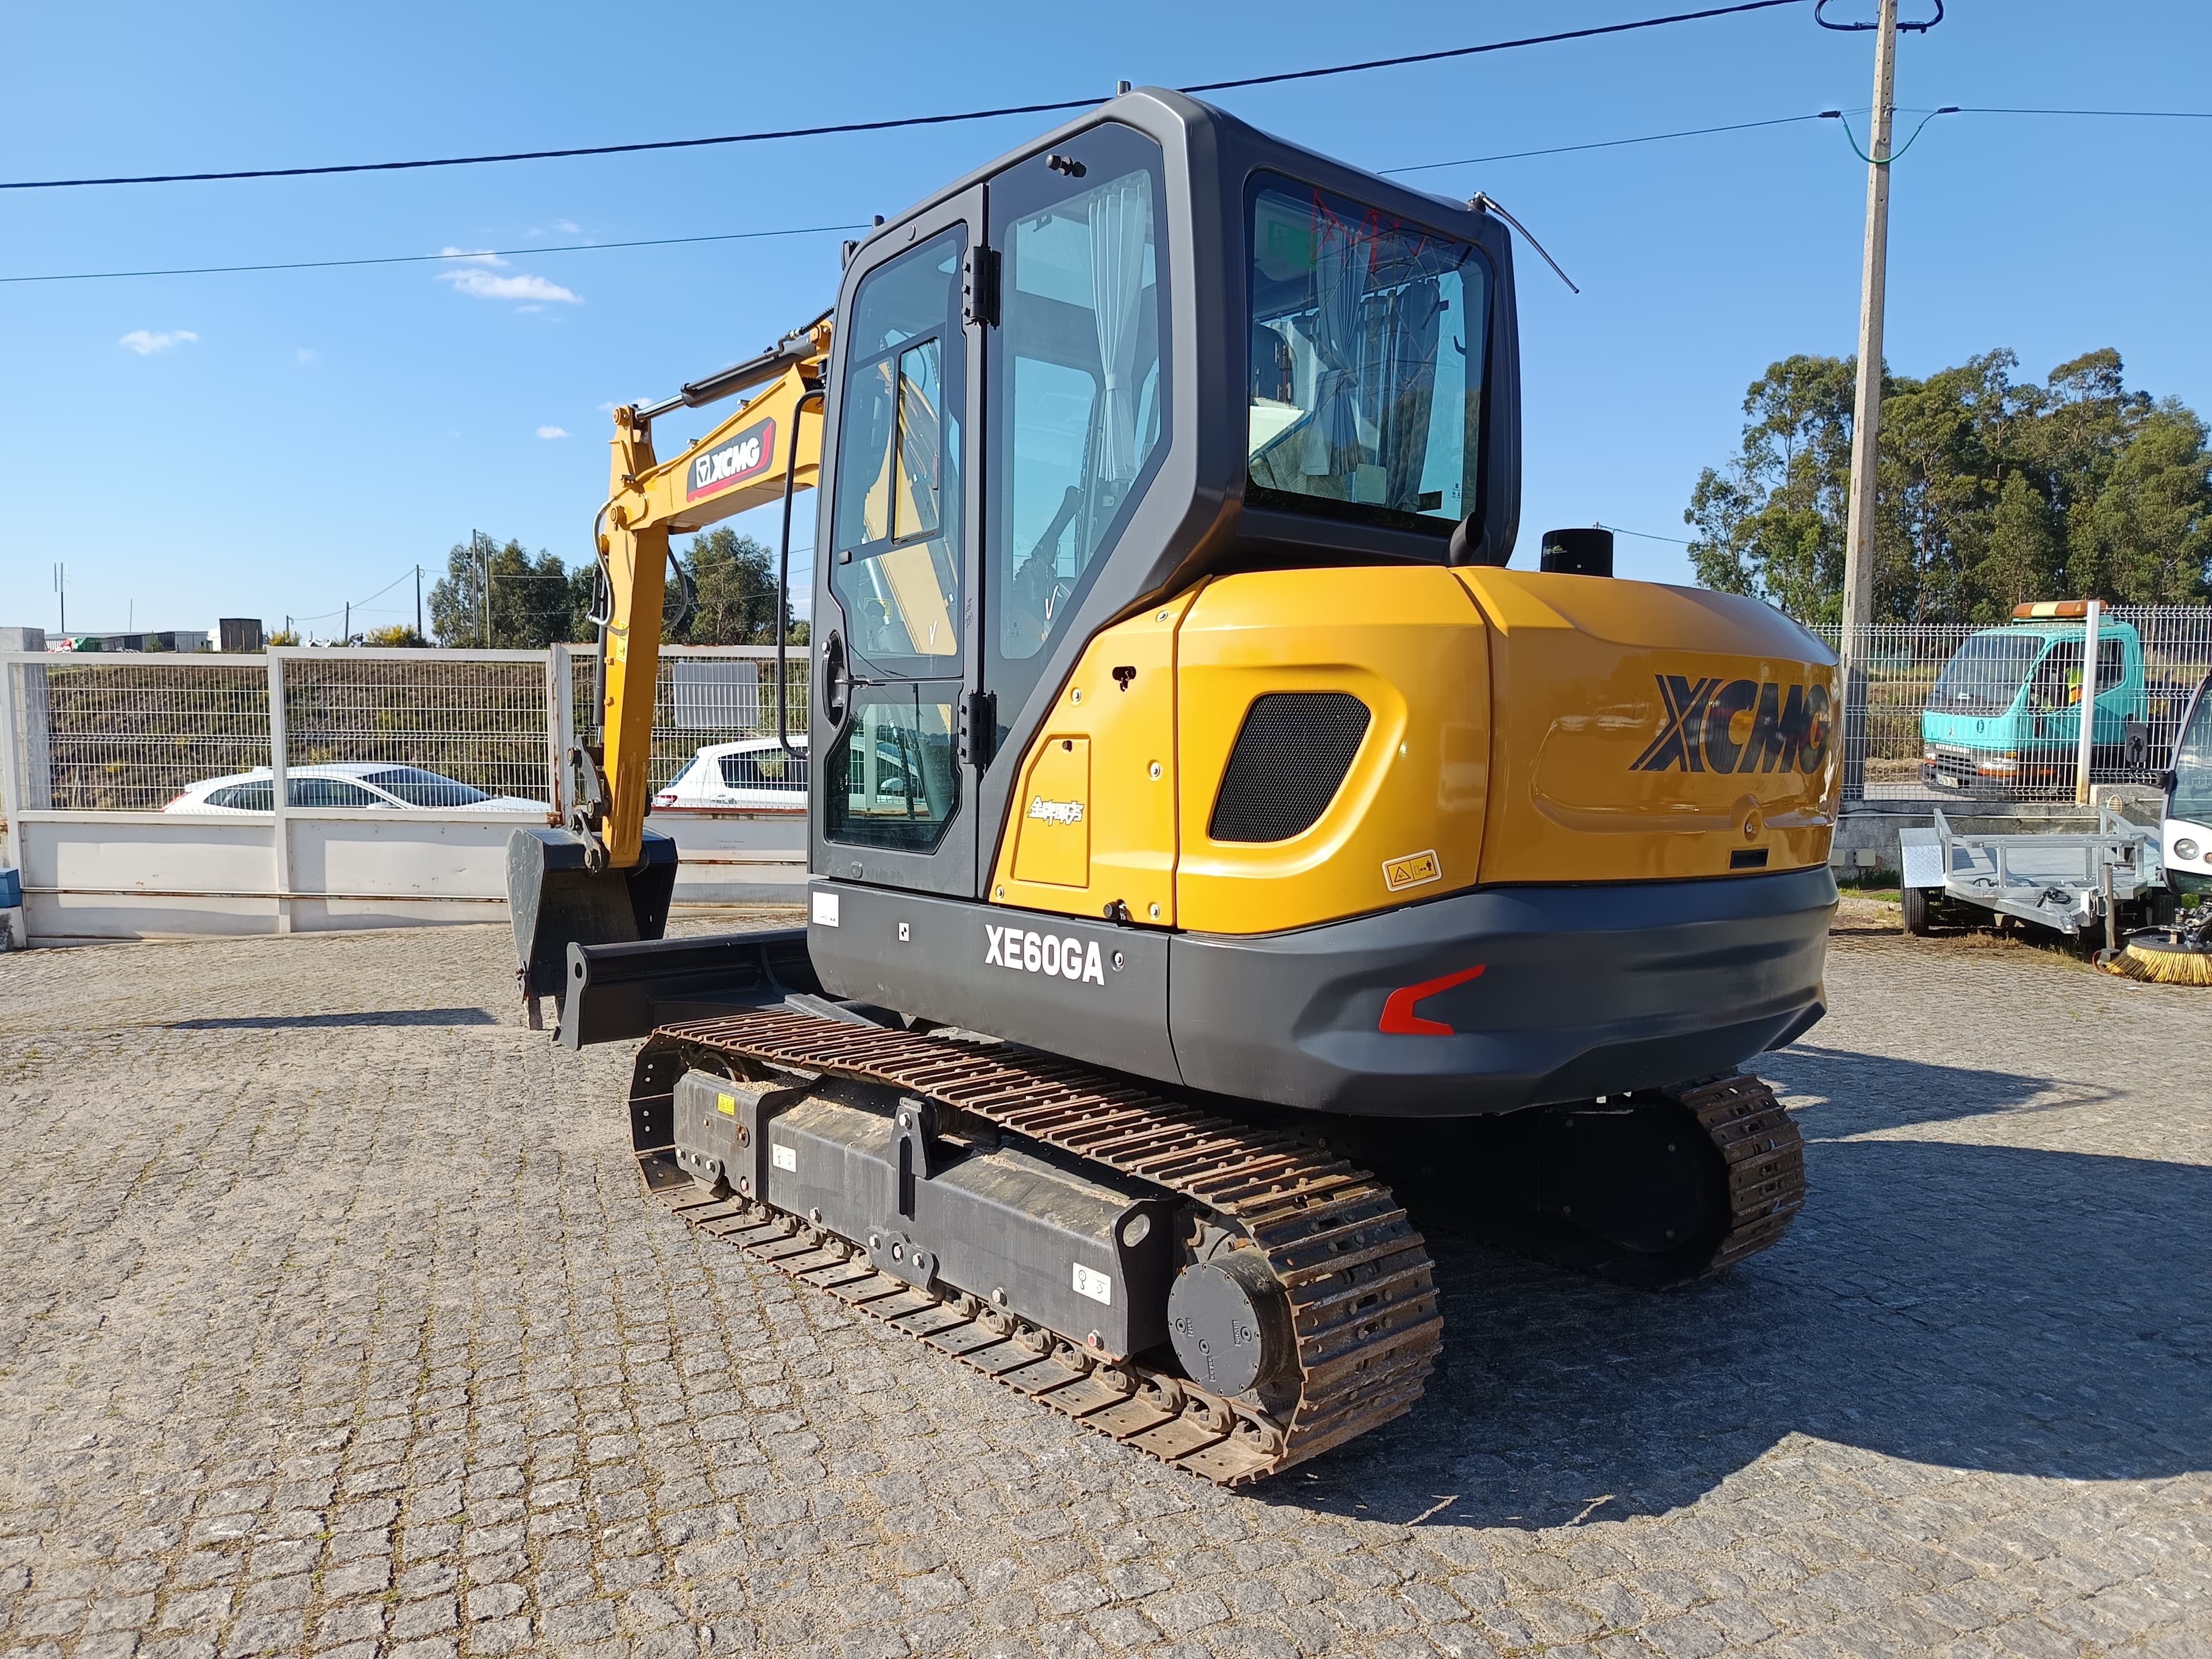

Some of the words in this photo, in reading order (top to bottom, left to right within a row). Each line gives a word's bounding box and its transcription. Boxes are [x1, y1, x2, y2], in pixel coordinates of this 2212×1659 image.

[710, 437, 760, 483] XCMG
[1628, 675, 1831, 774] XCMG
[984, 924, 1105, 986] XE60GA
[1232, 1320, 1241, 1345] DRAIN
